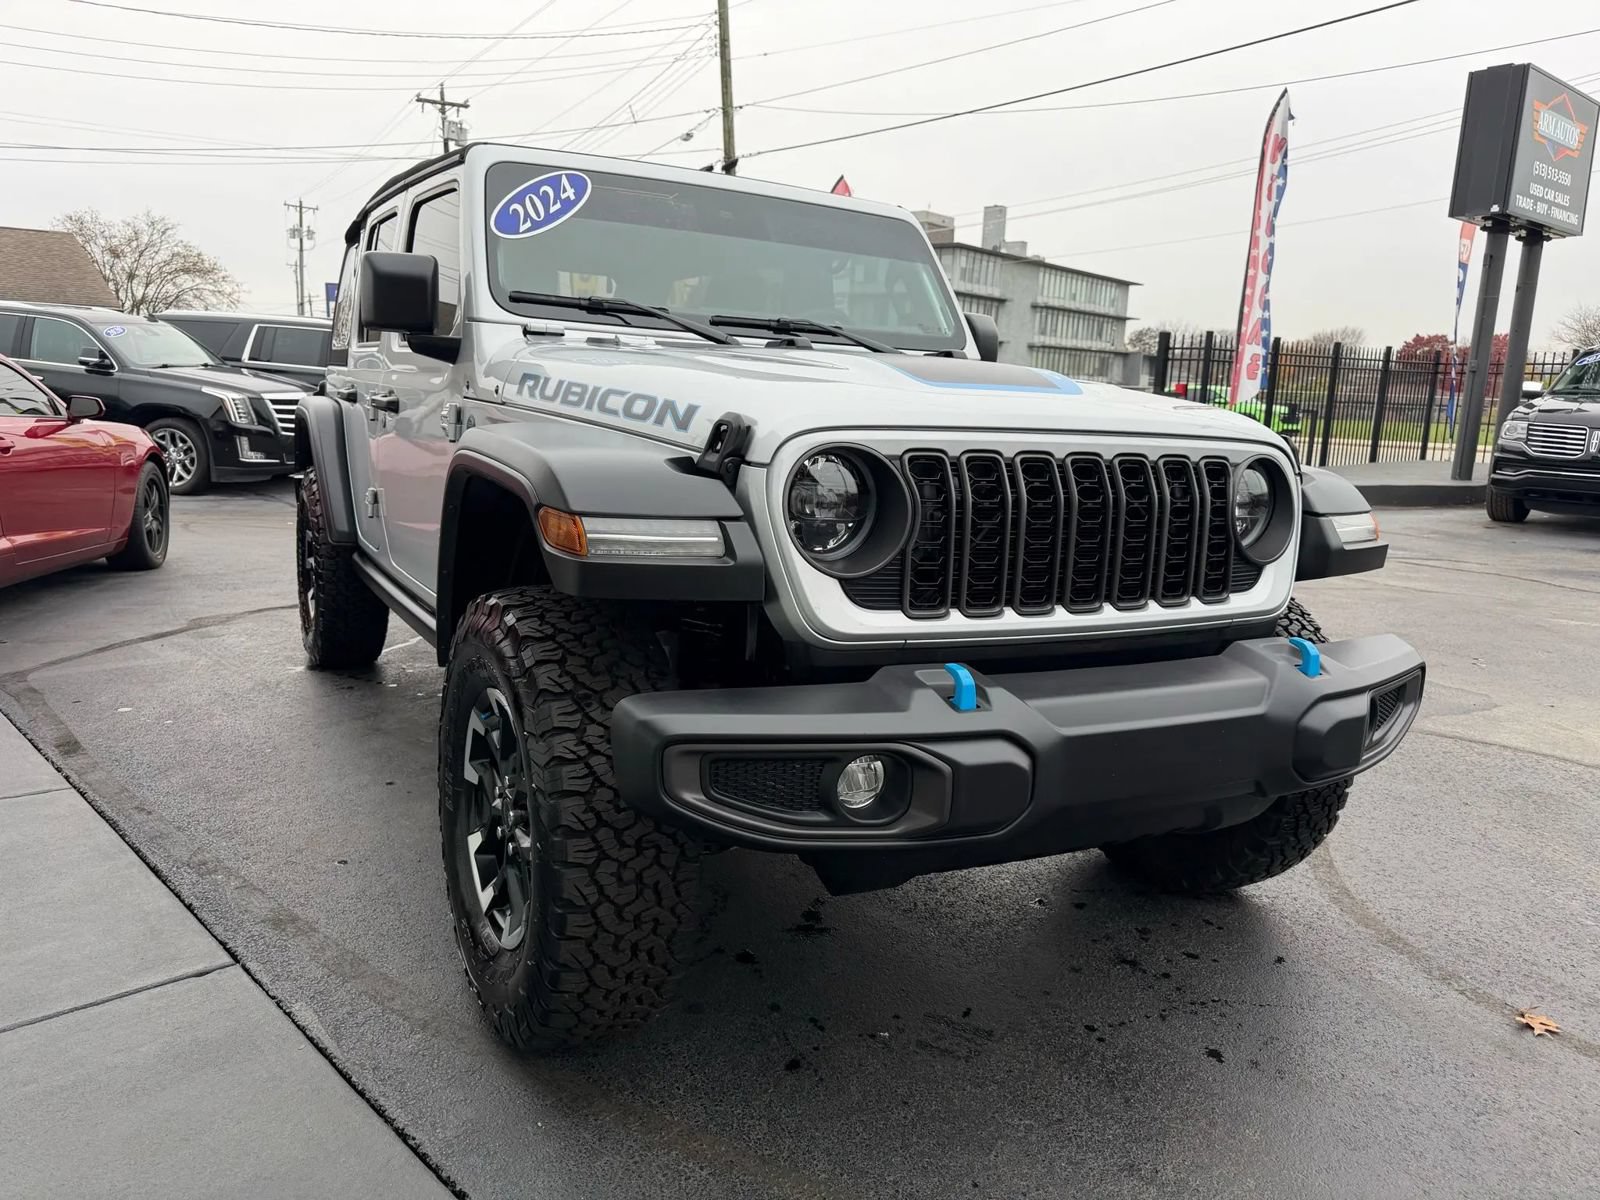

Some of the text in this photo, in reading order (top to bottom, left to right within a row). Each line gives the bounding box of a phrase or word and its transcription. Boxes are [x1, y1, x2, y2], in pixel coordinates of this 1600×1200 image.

[1533, 160, 1571, 187] (513) 513-5550
[509, 174, 576, 233] 2024
[1516, 194, 1534, 211] TRADE
[1536, 201, 1548, 216] BUY
[1550, 205, 1578, 225] FINANCING
[1530, 182, 1570, 207] USED CAR SALES
[516, 371, 701, 433] RUBICON
